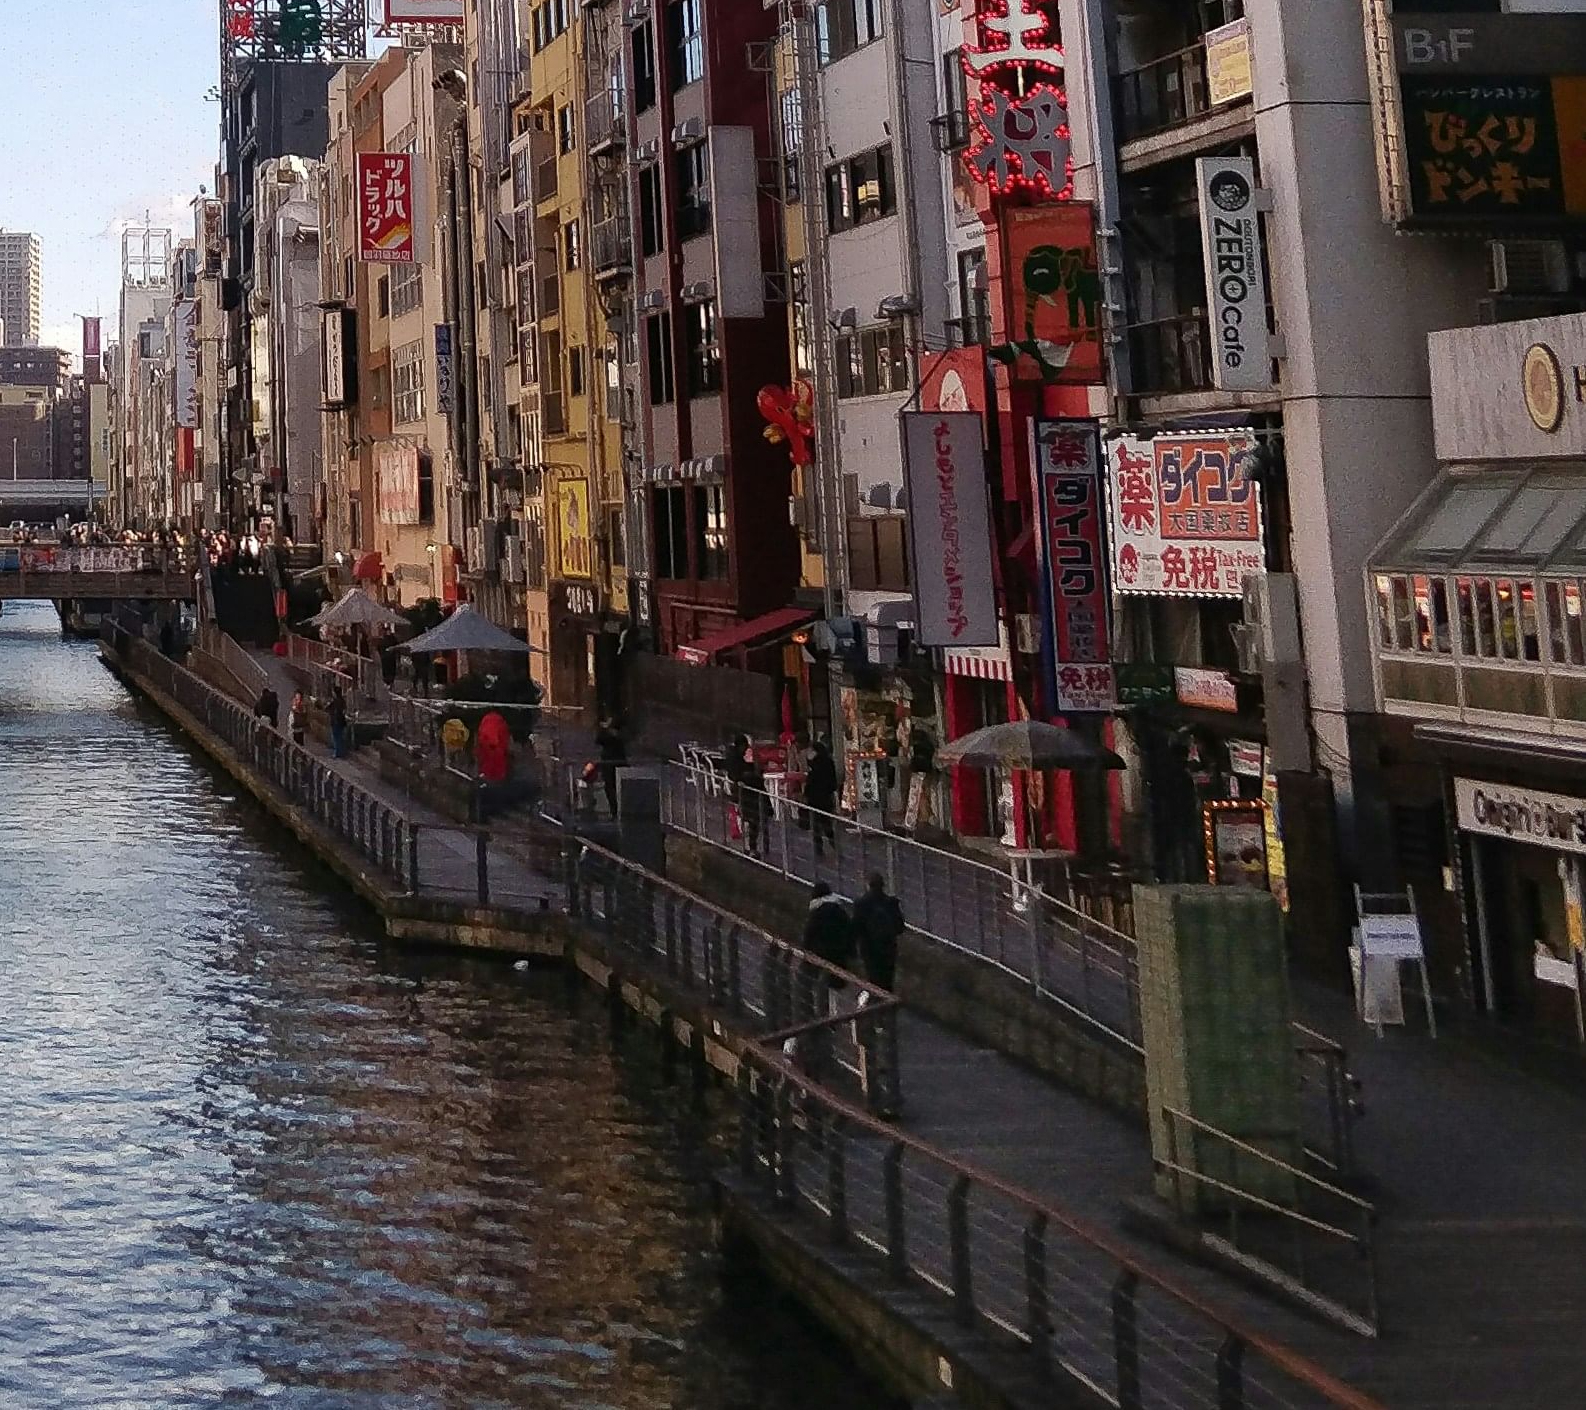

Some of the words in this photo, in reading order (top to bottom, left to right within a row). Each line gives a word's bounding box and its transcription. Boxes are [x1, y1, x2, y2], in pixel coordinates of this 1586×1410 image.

[1424, 109, 1537, 160] びっくり
[365, 168, 385, 235] ドラッグ
[384, 158, 407, 220] ツルハ
[1423, 157, 1552, 205] ドンキー
[1214, 217, 1248, 304] ZERO
[1222, 305, 1246, 369] cafe
